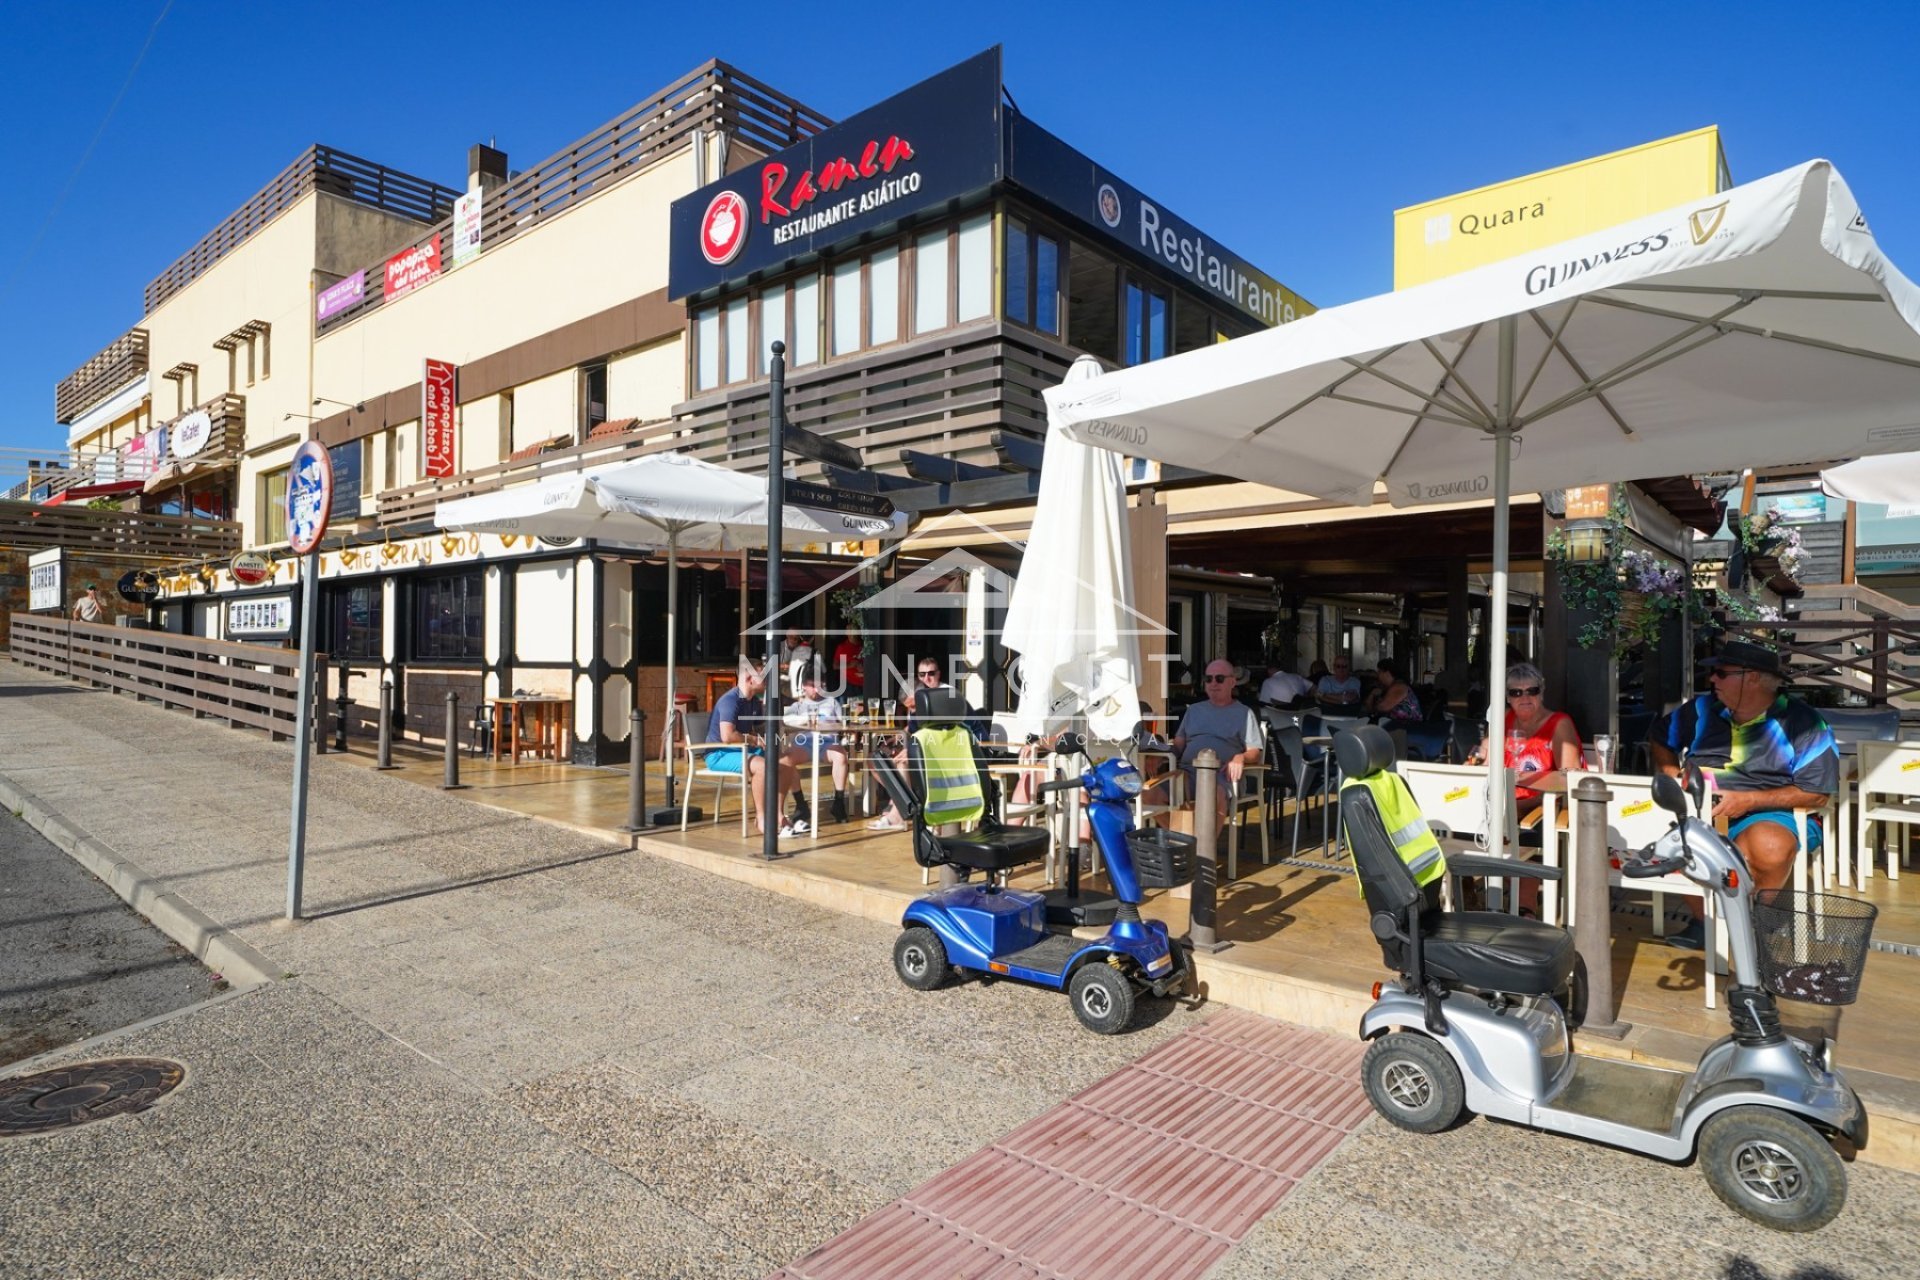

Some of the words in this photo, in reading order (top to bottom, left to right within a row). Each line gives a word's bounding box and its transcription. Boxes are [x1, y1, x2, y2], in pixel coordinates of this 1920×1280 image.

[761, 135, 914, 224] Ramen
[773, 198, 857, 245] RESTAURANTE
[859, 171, 922, 213] ASIÁTICO
[1459, 202, 1545, 235] Quara
[1140, 200, 1295, 324] Restaurante
[1524, 228, 1672, 296] GUINNESS
[427, 384, 439, 410] and
[427, 412, 438, 453] kebab
[121, 584, 158, 593] GUNESS
